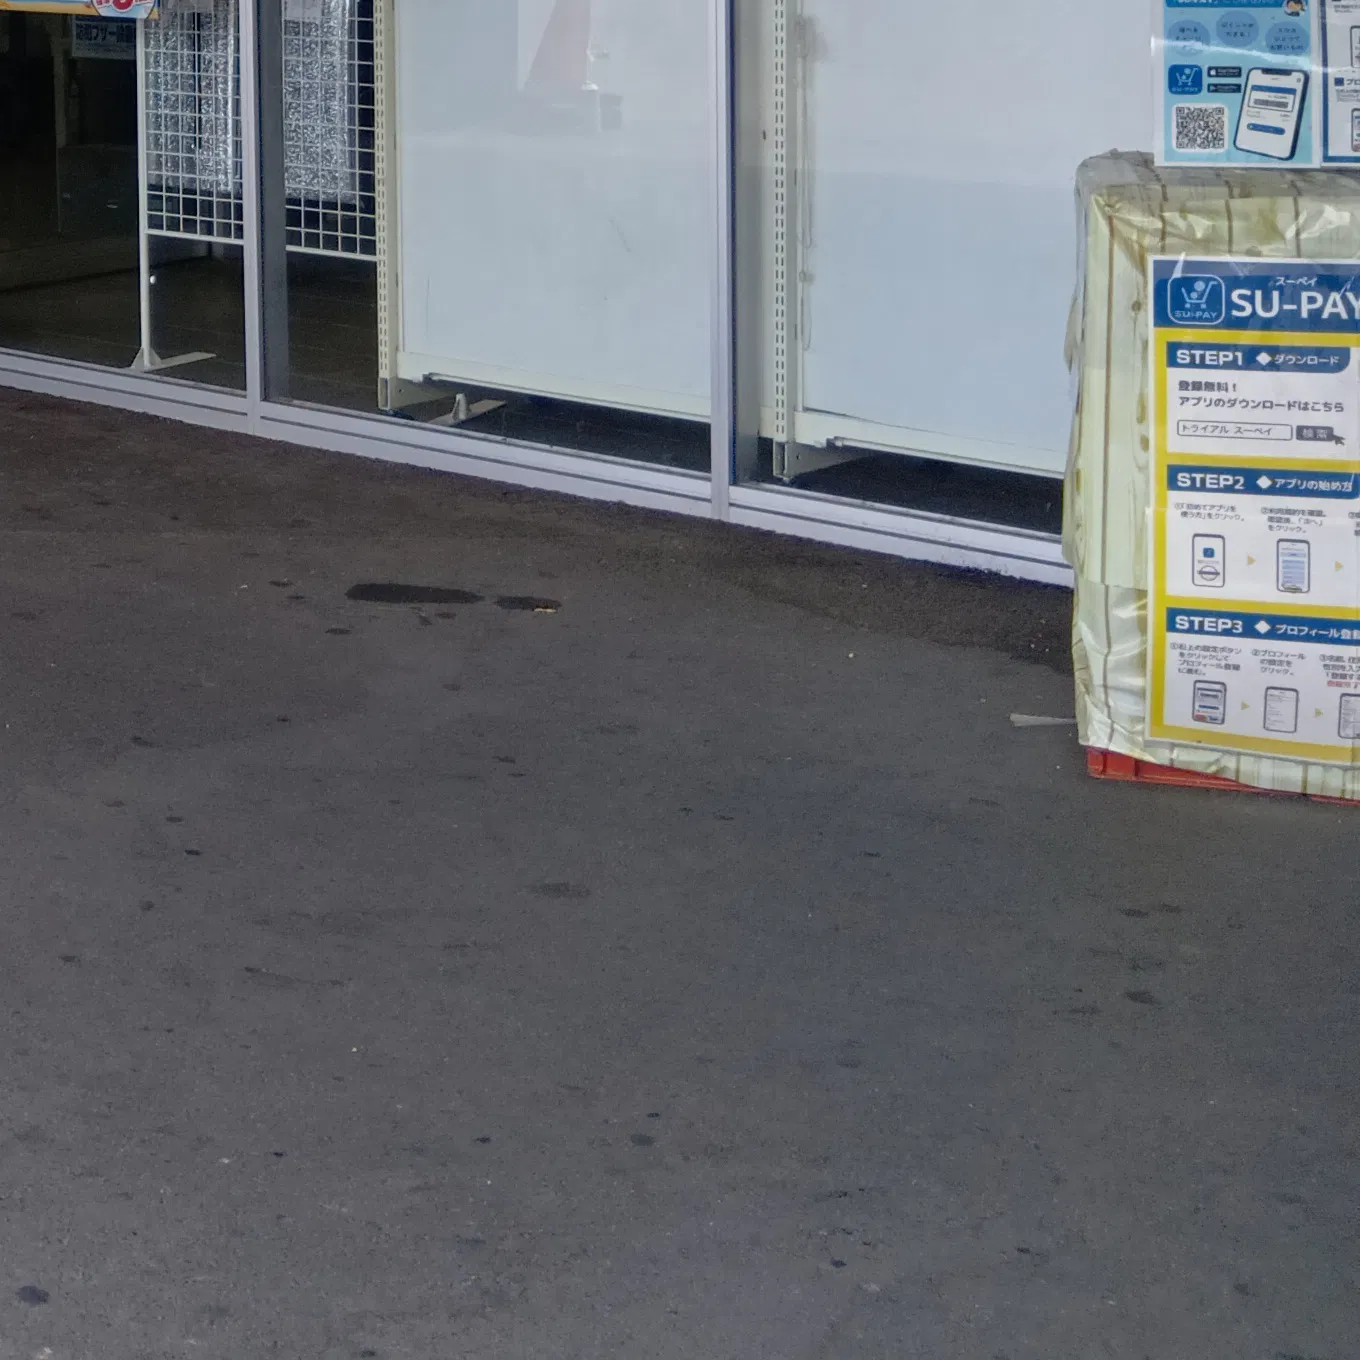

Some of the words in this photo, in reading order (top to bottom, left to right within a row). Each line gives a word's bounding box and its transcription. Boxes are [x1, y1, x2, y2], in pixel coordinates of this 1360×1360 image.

[1275, 276, 1317, 287] スーペイ
[1231, 289, 1360, 320] SU-PAY
[1176, 349, 1243, 366] STEP1
[1274, 354, 1340, 365] ダウンロード
[1178, 380, 1237, 393] 登録無料!
[1178, 396, 1345, 413] アプリのダウンロードはこちら
[1182, 424, 1229, 435] トライアル
[1234, 425, 1273, 436] スーペイ
[1177, 472, 1245, 490] STEP2
[1274, 478, 1353, 493] アプリの始め方
[1175, 616, 1243, 633] STEP3
